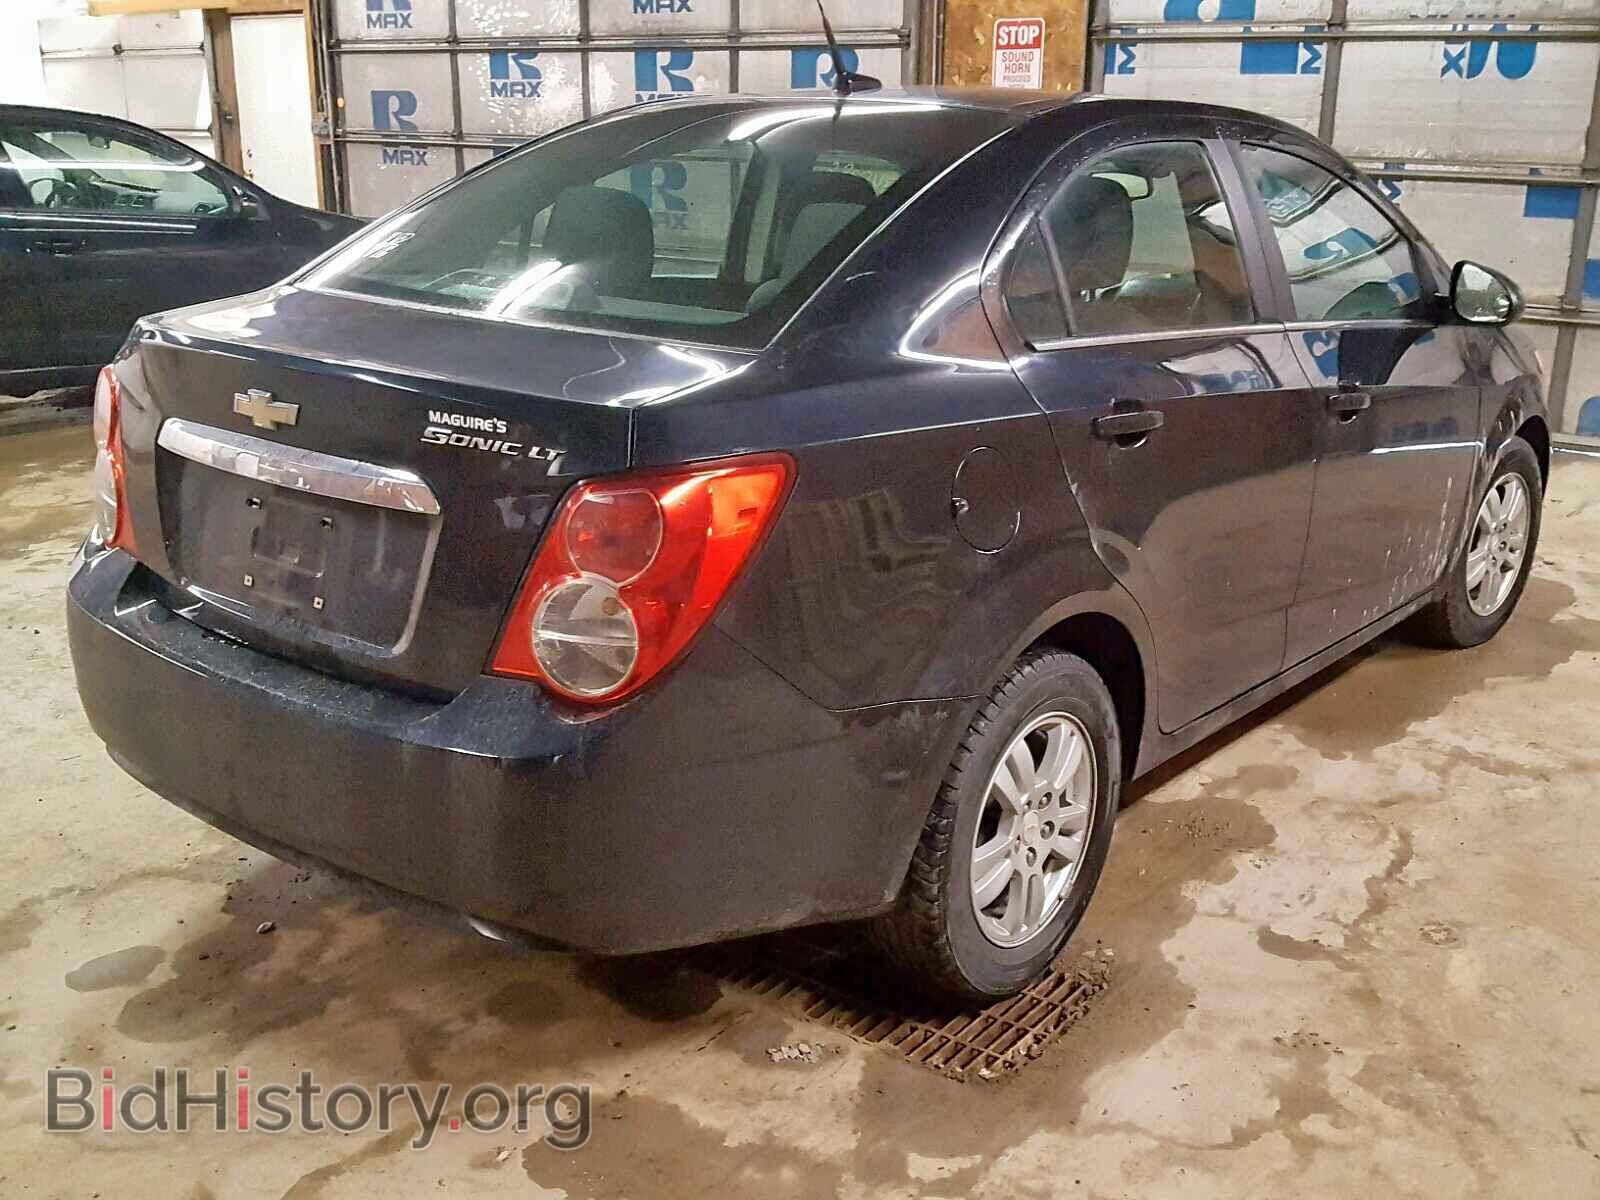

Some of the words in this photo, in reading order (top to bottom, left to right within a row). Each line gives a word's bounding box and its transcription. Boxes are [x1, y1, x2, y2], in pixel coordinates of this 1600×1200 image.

[633, 0, 694, 13] MAX
[366, 13, 412, 29] MAX
[998, 25, 1040, 46] STOP
[1002, 51, 1034, 63] SOUND
[634, 47, 695, 91] R
[1004, 63, 1031, 74] HORN
[490, 81, 544, 98] MAX
[371, 90, 418, 134] R
[383, 149, 428, 166] MAX
[428, 409, 508, 434] MAGUIRE'S
[420, 426, 523, 456] SONIC
